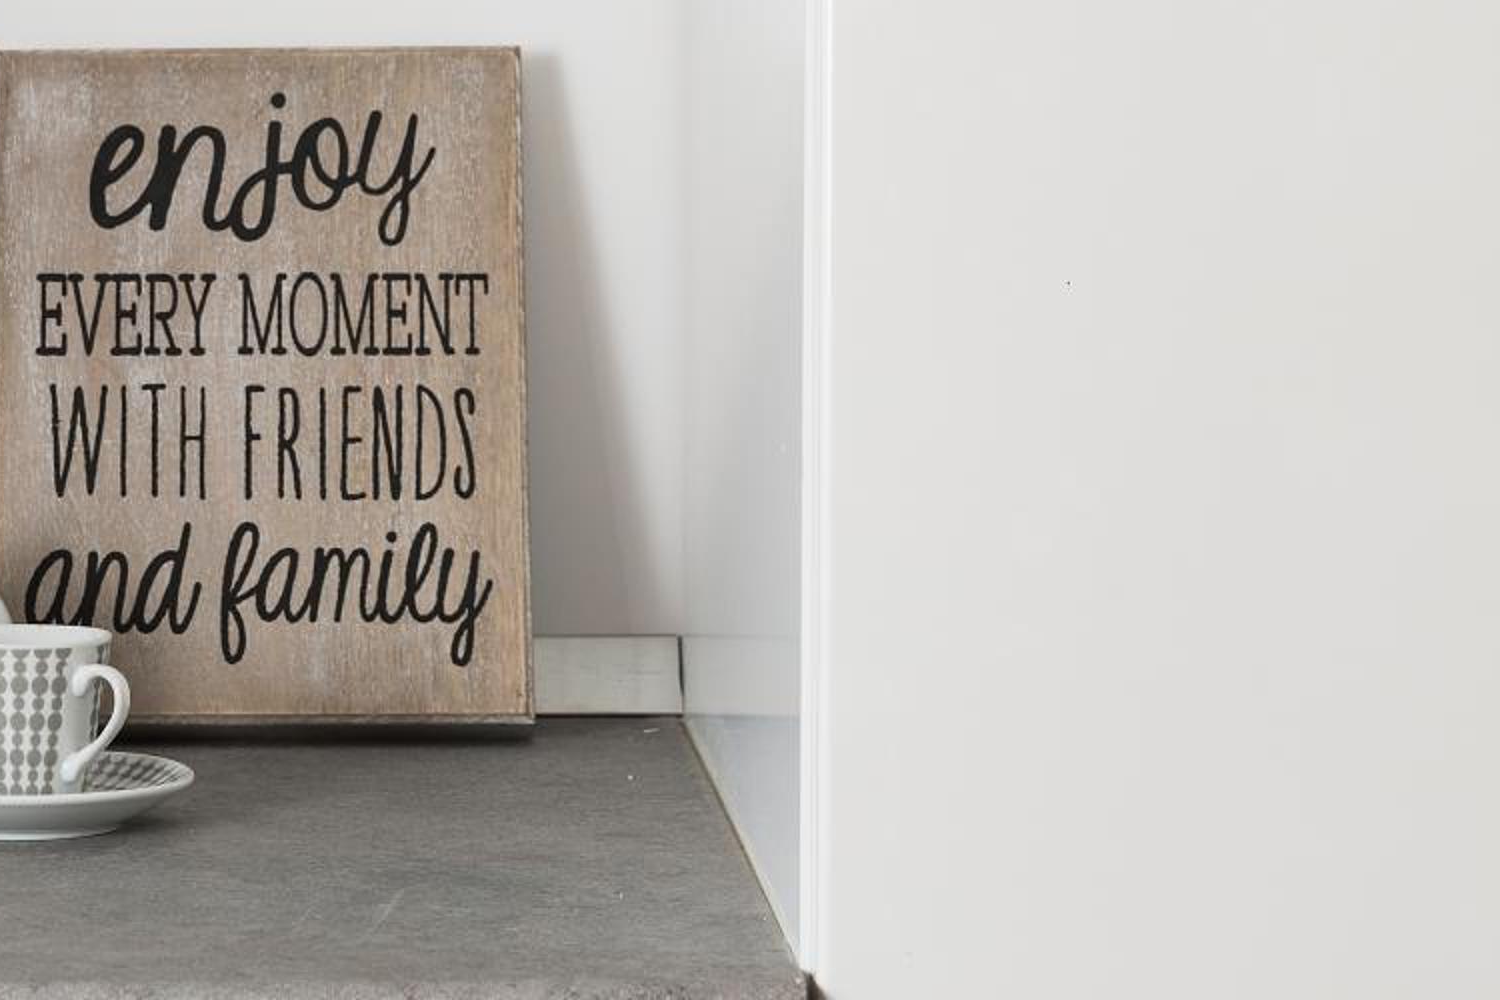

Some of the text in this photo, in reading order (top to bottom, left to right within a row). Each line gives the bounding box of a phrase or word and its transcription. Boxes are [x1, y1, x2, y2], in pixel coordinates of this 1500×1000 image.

[90, 92, 435, 246] enjoy
[35, 272, 489, 356] EVERY MOMENT
[50, 383, 476, 501] WITH FRIENDS
[24, 521, 493, 667] and family
